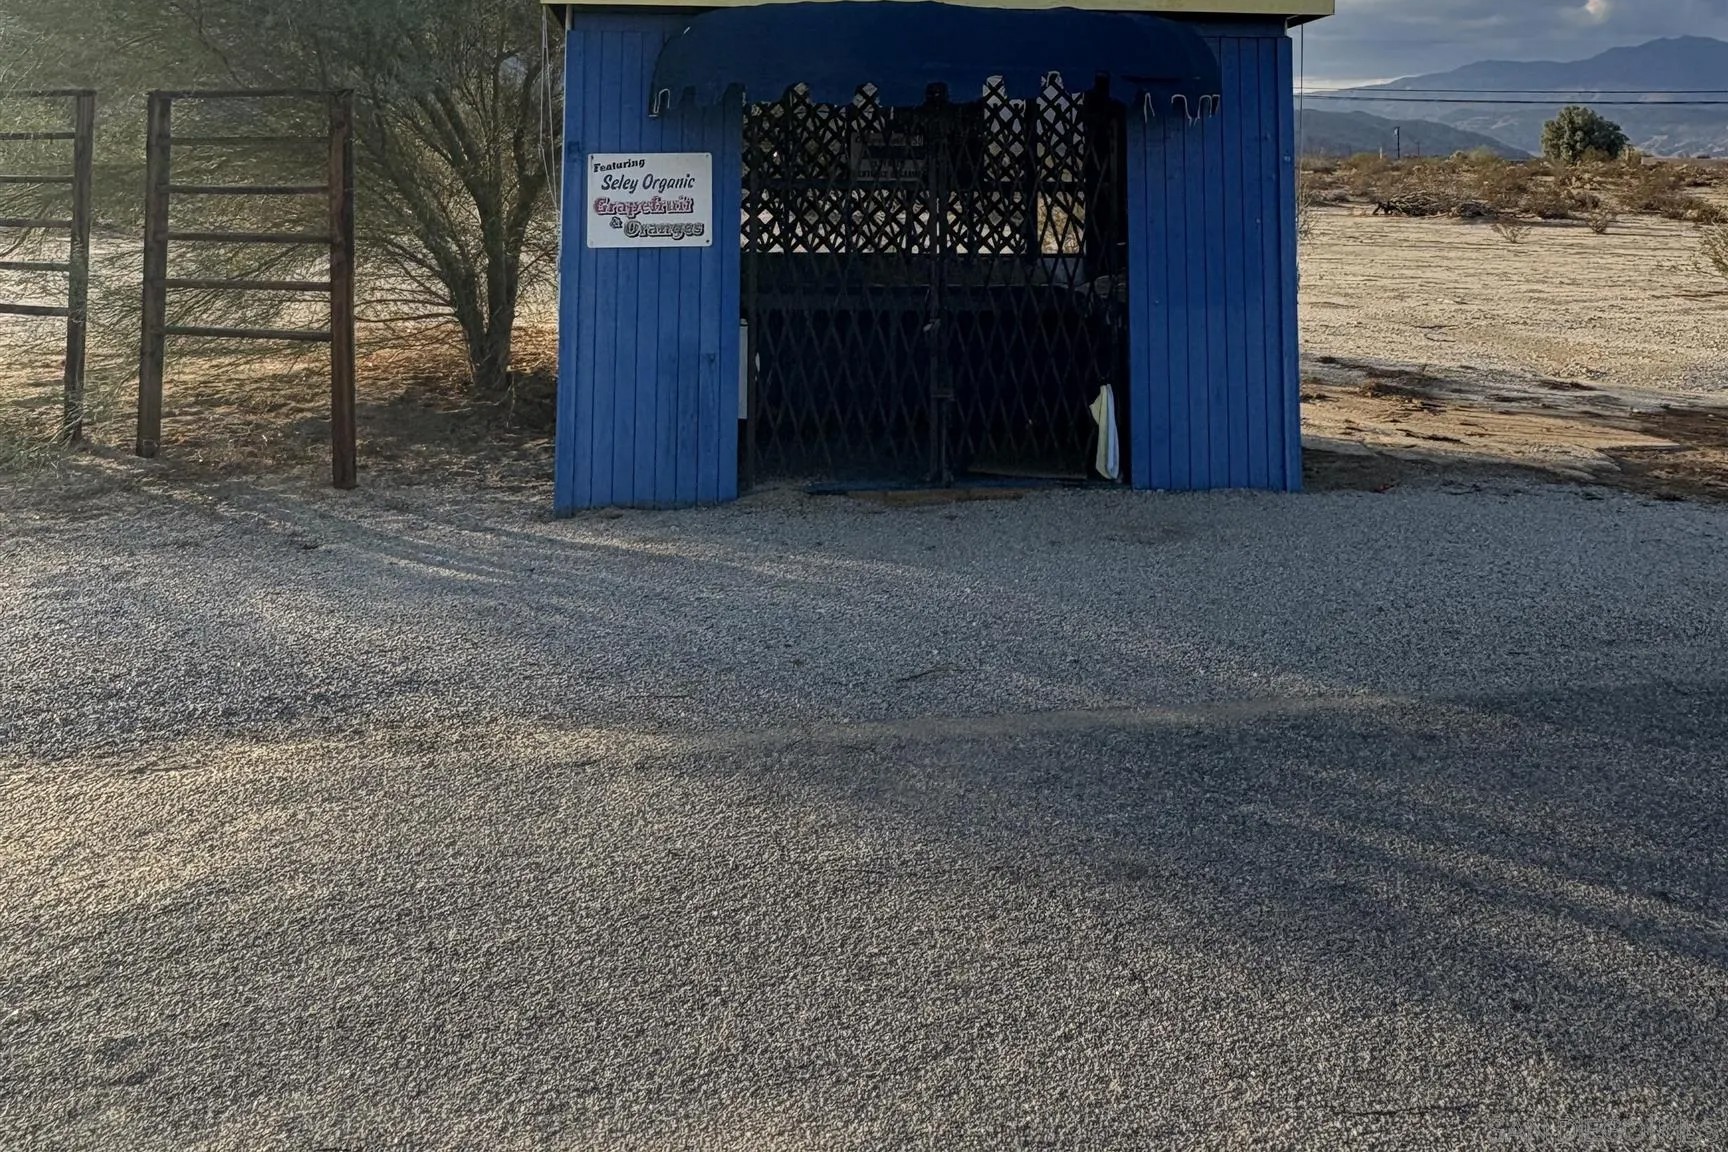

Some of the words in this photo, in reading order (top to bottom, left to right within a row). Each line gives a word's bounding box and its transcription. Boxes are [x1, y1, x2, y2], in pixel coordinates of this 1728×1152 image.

[593, 159, 645, 172] Featuring
[601, 174, 638, 193] Seley
[642, 173, 695, 193] Organic
[594, 196, 694, 218] Grapefruit
[624, 220, 704, 240] Oranges
